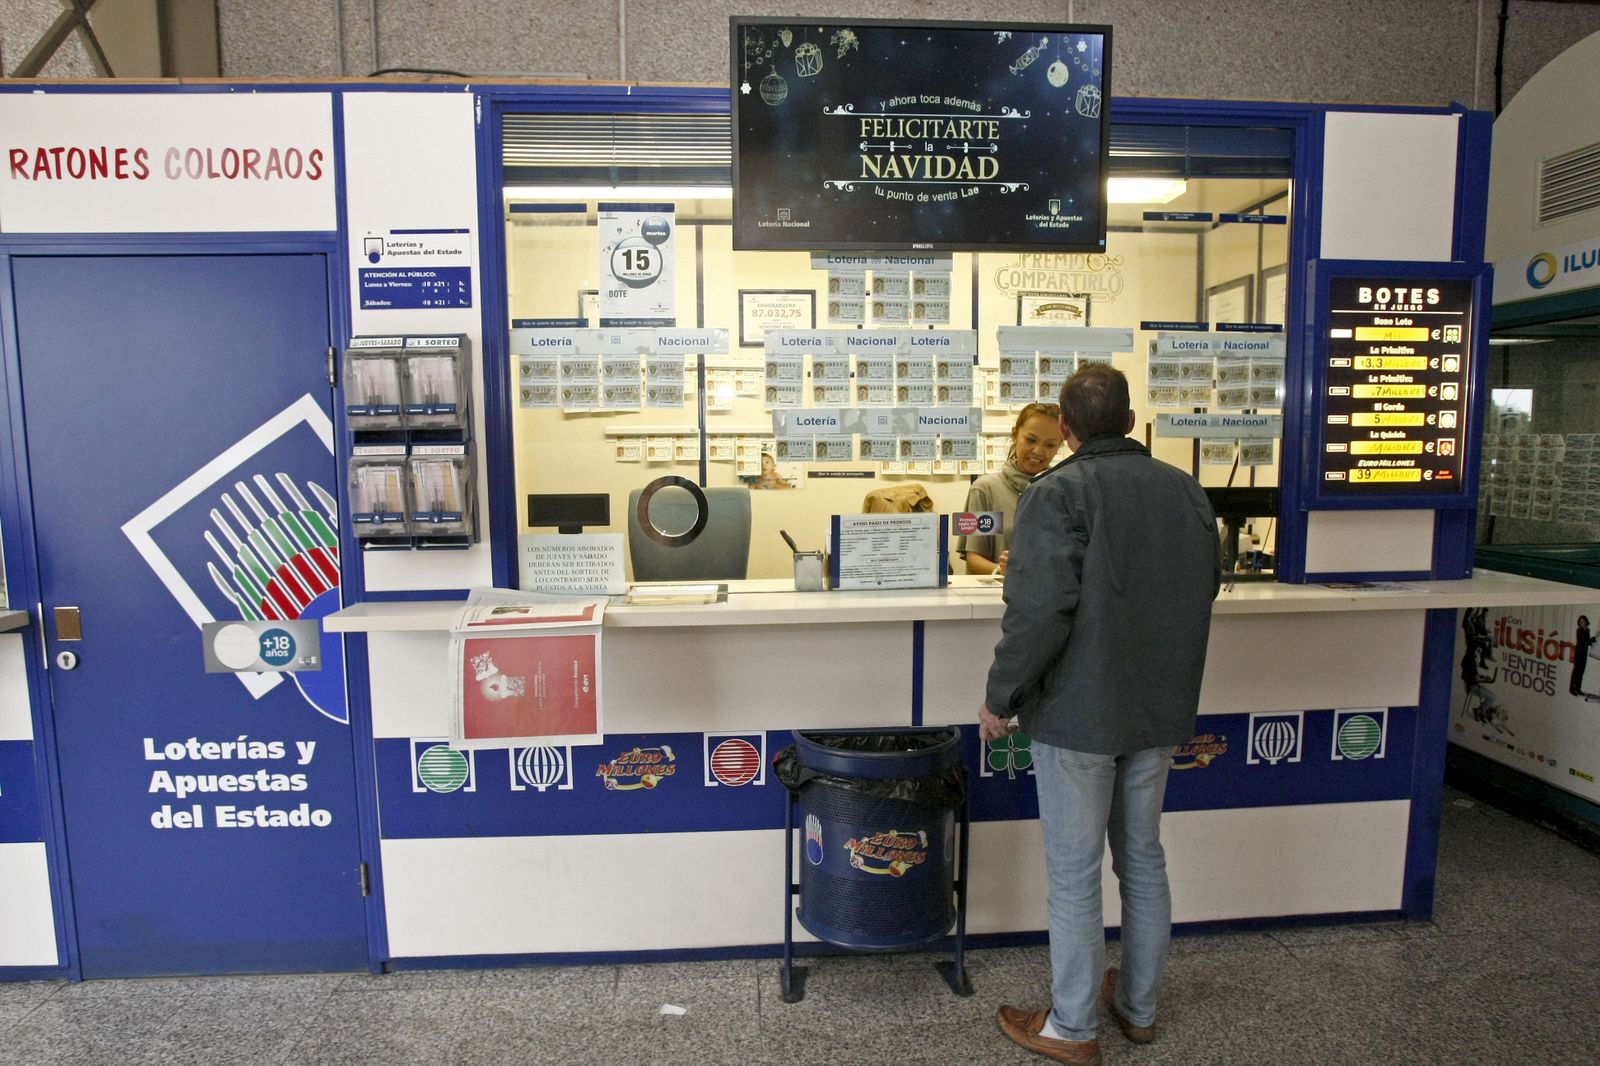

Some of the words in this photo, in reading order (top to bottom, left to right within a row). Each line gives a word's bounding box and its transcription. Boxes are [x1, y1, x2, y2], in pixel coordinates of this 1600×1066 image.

[880, 101, 885, 111] y
[889, 95, 916, 107] ahora
[920, 94, 940, 104] toca
[944, 96, 982, 112] además
[860, 118, 1000, 139] FELICITARTE
[924, 142, 933, 151] la
[9, 146, 150, 181] RATONES
[164, 147, 324, 181] COLORAOS
[860, 155, 999, 180] NAVIDAD
[875, 185, 885, 196] tu
[887, 189, 914, 201] punto
[917, 191, 928, 201] de
[932, 191, 958, 202] venta
[960, 186, 980, 198] Lae
[622, 249, 650, 270] 15
[827, 255, 867, 264] Lotería
[885, 255, 935, 264] Nacional
[1564, 249, 1600, 273] ILU
[997, 269, 1121, 293] COMPARTIRLO
[609, 290, 628, 298] BOTE
[1359, 287, 1439, 304] BOTES
[752, 309, 801, 319] 87.032,75
[1374, 317, 1393, 325] Bono
[1395, 317, 1413, 325] Loto
[1431, 329, 1441, 340] €
[531, 336, 572, 347] Lotería
[658, 336, 710, 346] Nacional
[782, 336, 822, 346] Lotería
[847, 336, 897, 346] Nacional
[911, 336, 950, 346] Lotería
[1172, 341, 1208, 349] Lotería
[1224, 341, 1269, 350] Nacional
[1370, 346, 1379, 354] La
[1381, 346, 1415, 354] Primitiva
[1430, 358, 1440, 369] €
[1369, 375, 1378, 383] La
[1380, 374, 1413, 383] Primitiva
[1428, 386, 1438, 396] €
[1374, 403, 1382, 411] El
[1383, 403, 1405, 411] Gordo
[796, 416, 837, 426] Lotería
[919, 416, 968, 425] Nacional
[1171, 417, 1207, 426] Lotería
[1222, 418, 1267, 426] Nacional
[1374, 414, 1380, 423] 5
[1427, 414, 1436, 425] €
[1425, 442, 1435, 453] €
[1357, 469, 1371, 480] 39
[1424, 470, 1433, 480] €
[1507, 616, 1522, 626] Con
[263, 636, 290, 650] +18
[1493, 617, 1577, 663] ilusión
[265, 647, 289, 657] años
[1508, 654, 1557, 680] ENTRE
[1502, 668, 1555, 696] TODOS
[144, 735, 285, 761] Loterías
[296, 741, 316, 765] y
[618, 752, 662, 764] EURO
[148, 769, 308, 799] Apuestas
[151, 804, 203, 829] del
[215, 803, 332, 828] Estado
[869, 832, 918, 849] EURO
